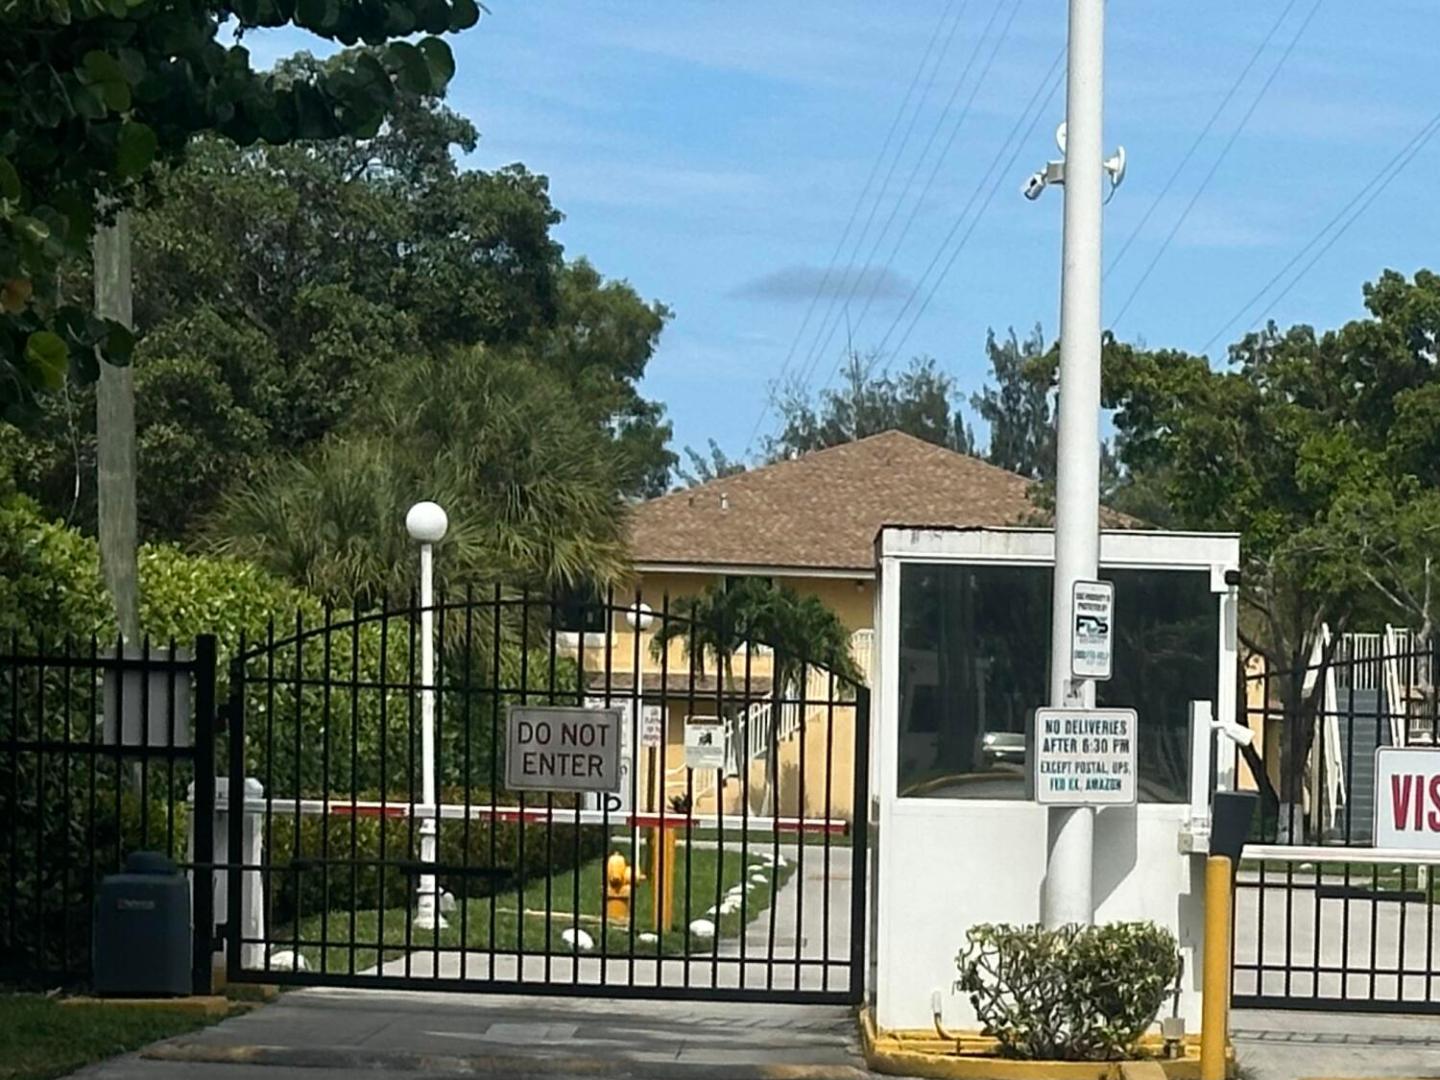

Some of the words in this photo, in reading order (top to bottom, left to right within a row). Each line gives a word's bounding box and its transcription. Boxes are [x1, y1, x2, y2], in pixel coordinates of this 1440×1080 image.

[517, 721, 551, 745] DO
[561, 723, 610, 747] NOT
[1045, 719, 1060, 734] NO
[1065, 719, 1127, 735] DELIVERIES
[1043, 738, 1077, 753] AFTER
[1113, 739, 1130, 753] PM
[522, 752, 604, 777] ENTER
[1040, 761, 1072, 774] EXCEPT
[1085, 778, 1121, 791] AMAZON
